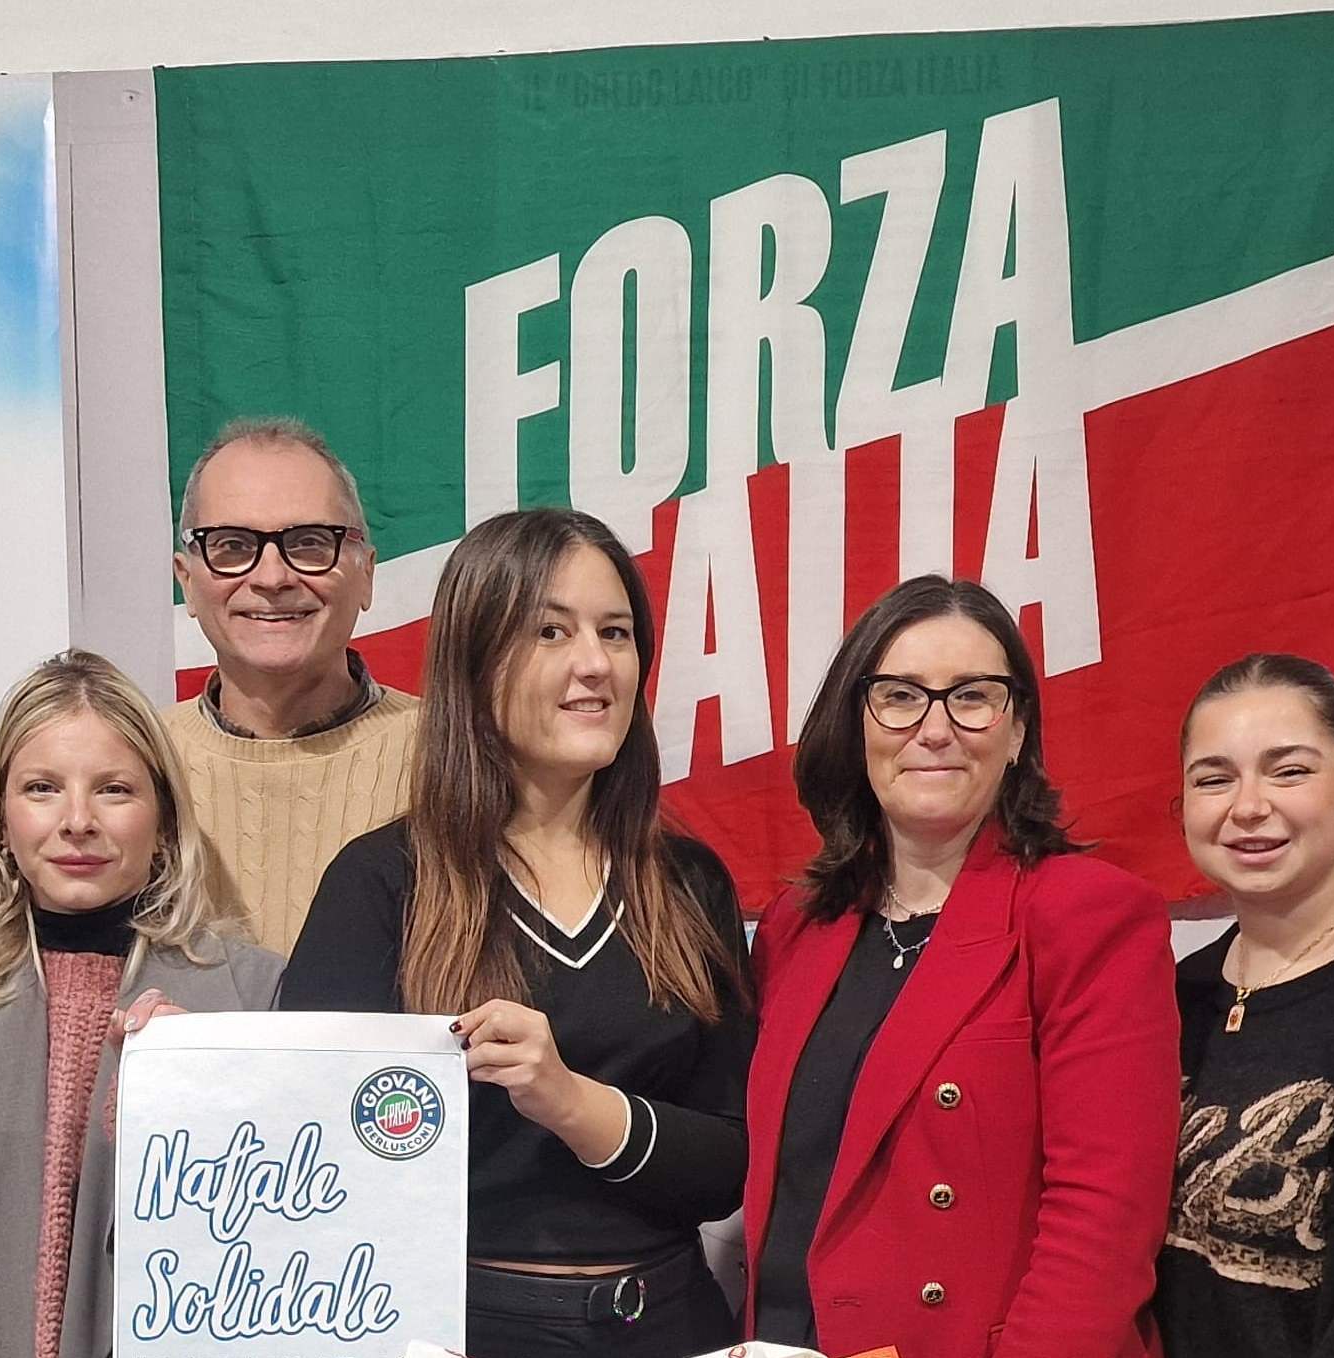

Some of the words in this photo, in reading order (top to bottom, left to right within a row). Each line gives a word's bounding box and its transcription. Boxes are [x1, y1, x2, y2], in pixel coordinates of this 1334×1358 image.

[464, 97, 1074, 545] FORZA
[362, 1074, 438, 1110] GIOVANI
[364, 1125, 433, 1151] BERLUSCONI
[134, 1121, 347, 1243] Natale
[132, 1241, 399, 1341] Solidale
